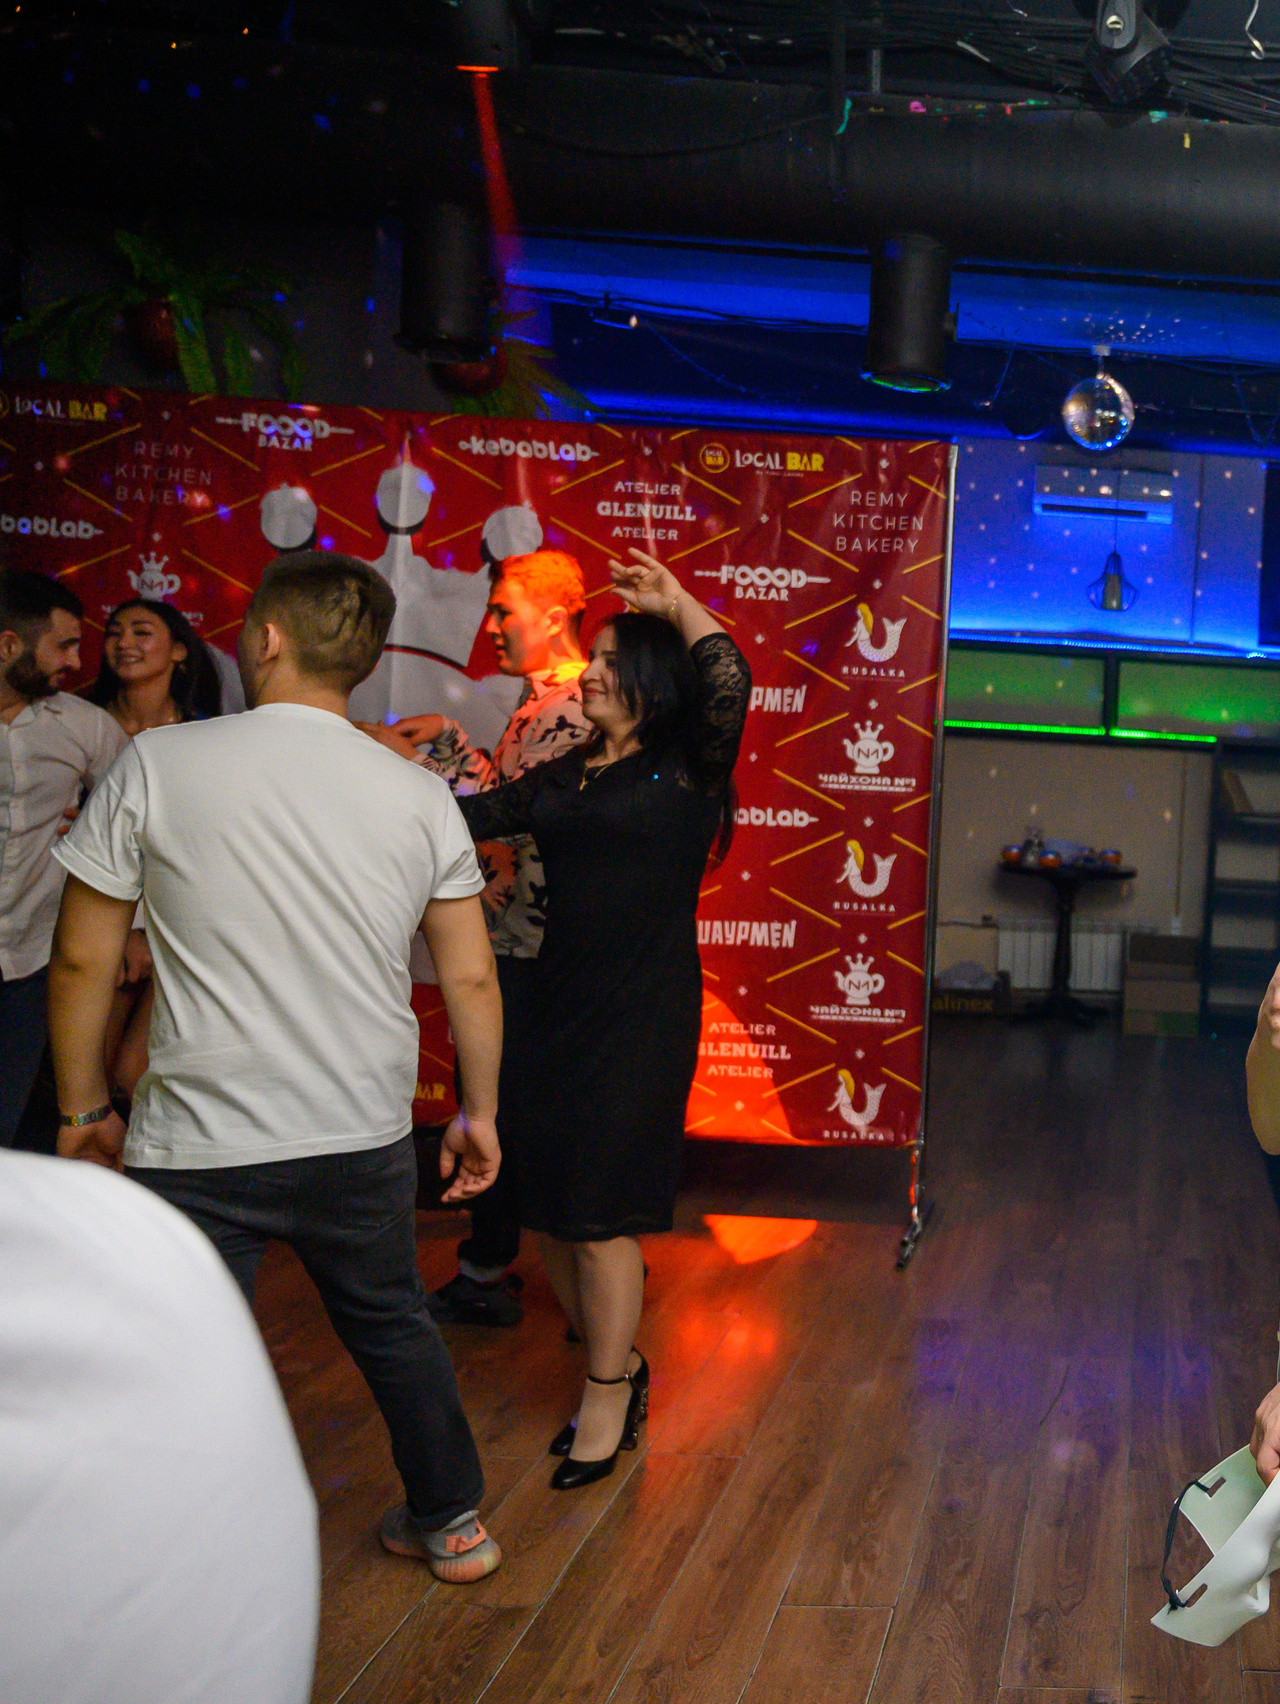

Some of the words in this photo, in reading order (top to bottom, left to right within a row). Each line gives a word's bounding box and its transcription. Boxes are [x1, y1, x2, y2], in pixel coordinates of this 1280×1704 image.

[15, 396, 65, 418] LOCAL
[68, 400, 107, 421] BAR
[241, 413, 330, 439] FOOOD
[135, 441, 193, 459] REMY
[258, 434, 312, 452] BAZAR
[735, 449, 784, 470] LOCAL
[786, 452, 824, 472] BAR
[115, 463, 212, 485] KITCHEN
[116, 485, 207, 506] BAKERY
[614, 481, 681, 496] ATELIER
[850, 490, 908, 508] REMY
[0, 513, 95, 540] babLab
[833, 513, 924, 531] KITCHEN
[612, 526, 679, 541] ATELIER
[836, 536, 919, 554] BAKERY
[720, 565, 808, 589] FOOOD
[735, 585, 789, 602] BAZAR
[842, 666, 906, 678] RUSALKA
[735, 806, 810, 828] abLab
[833, 901, 896, 912] RUSALKA
[709, 1022, 776, 1036] ATELIER
[707, 1064, 774, 1078] ATELIER
[823, 1129, 885, 1141] RUSALKA
